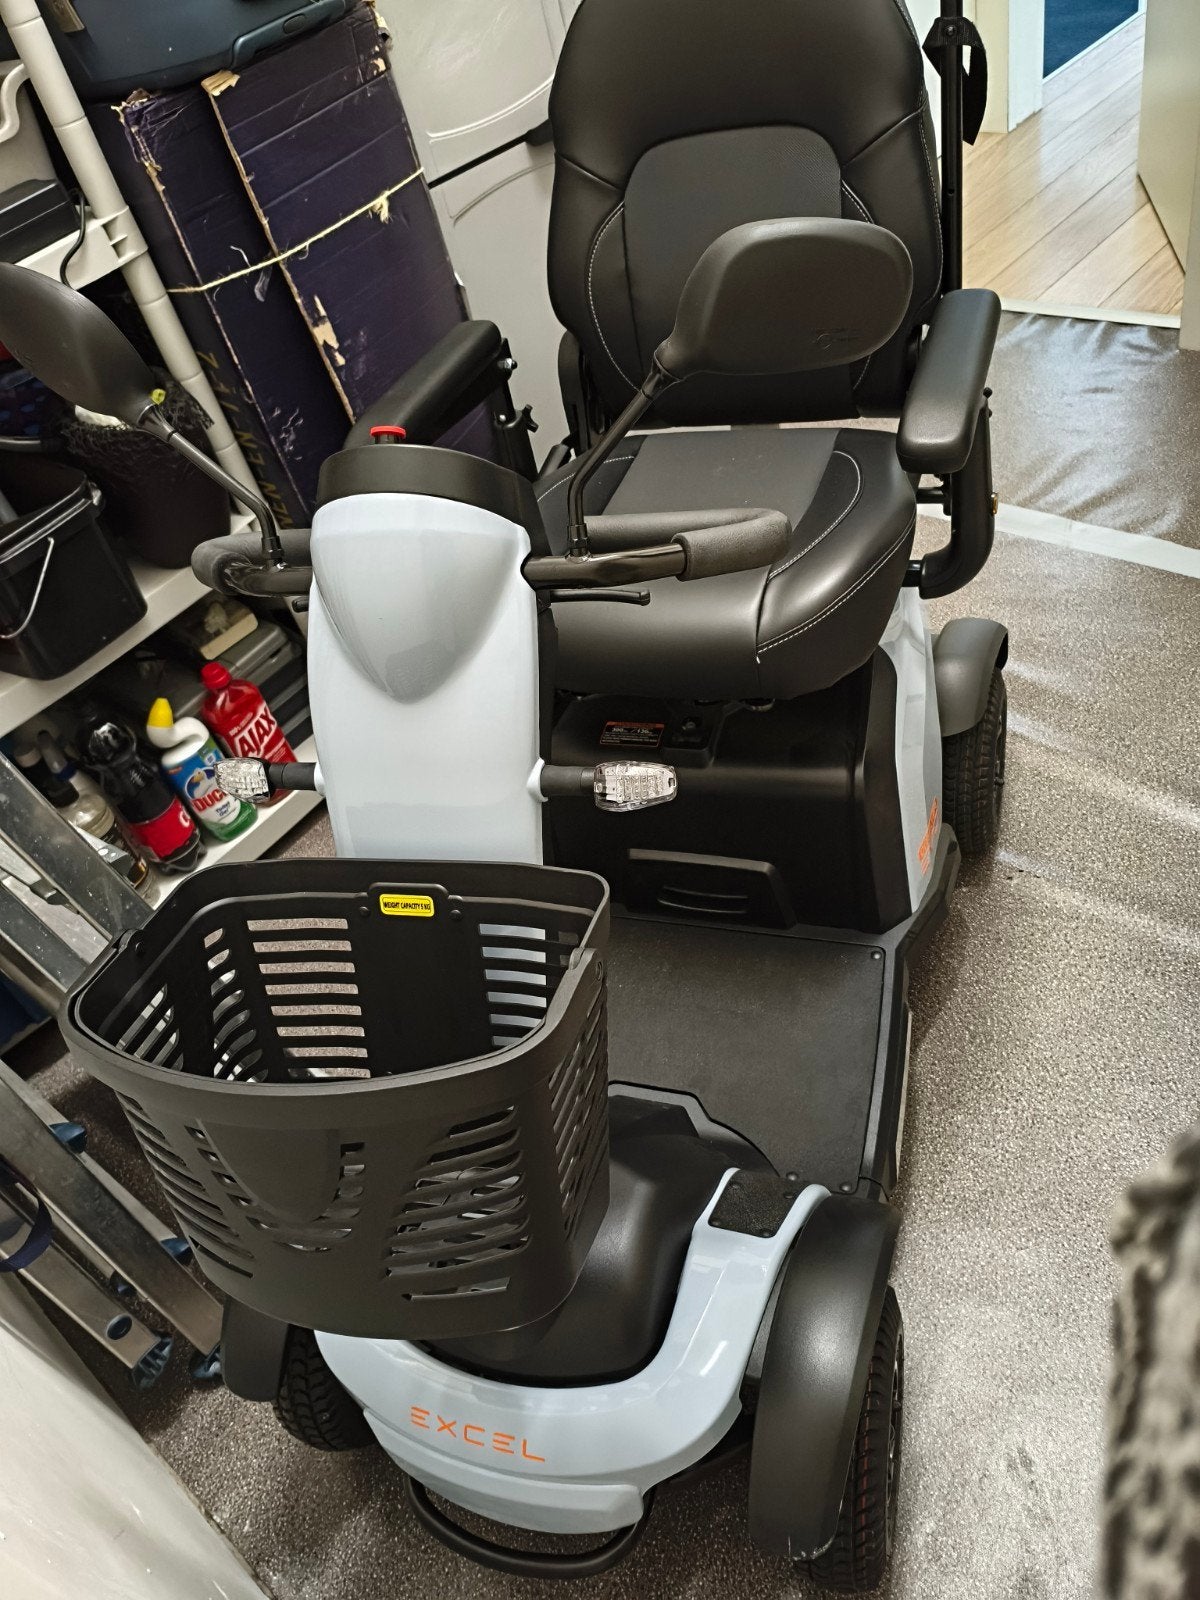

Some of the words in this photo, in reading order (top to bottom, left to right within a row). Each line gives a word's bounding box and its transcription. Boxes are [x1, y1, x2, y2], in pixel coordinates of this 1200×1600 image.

[237, 705, 276, 758] AJAX
[384, 901, 400, 909] WEIGHT
[401, 902, 420, 910] CAPACITY
[410, 1406, 546, 1463] EXCEL
